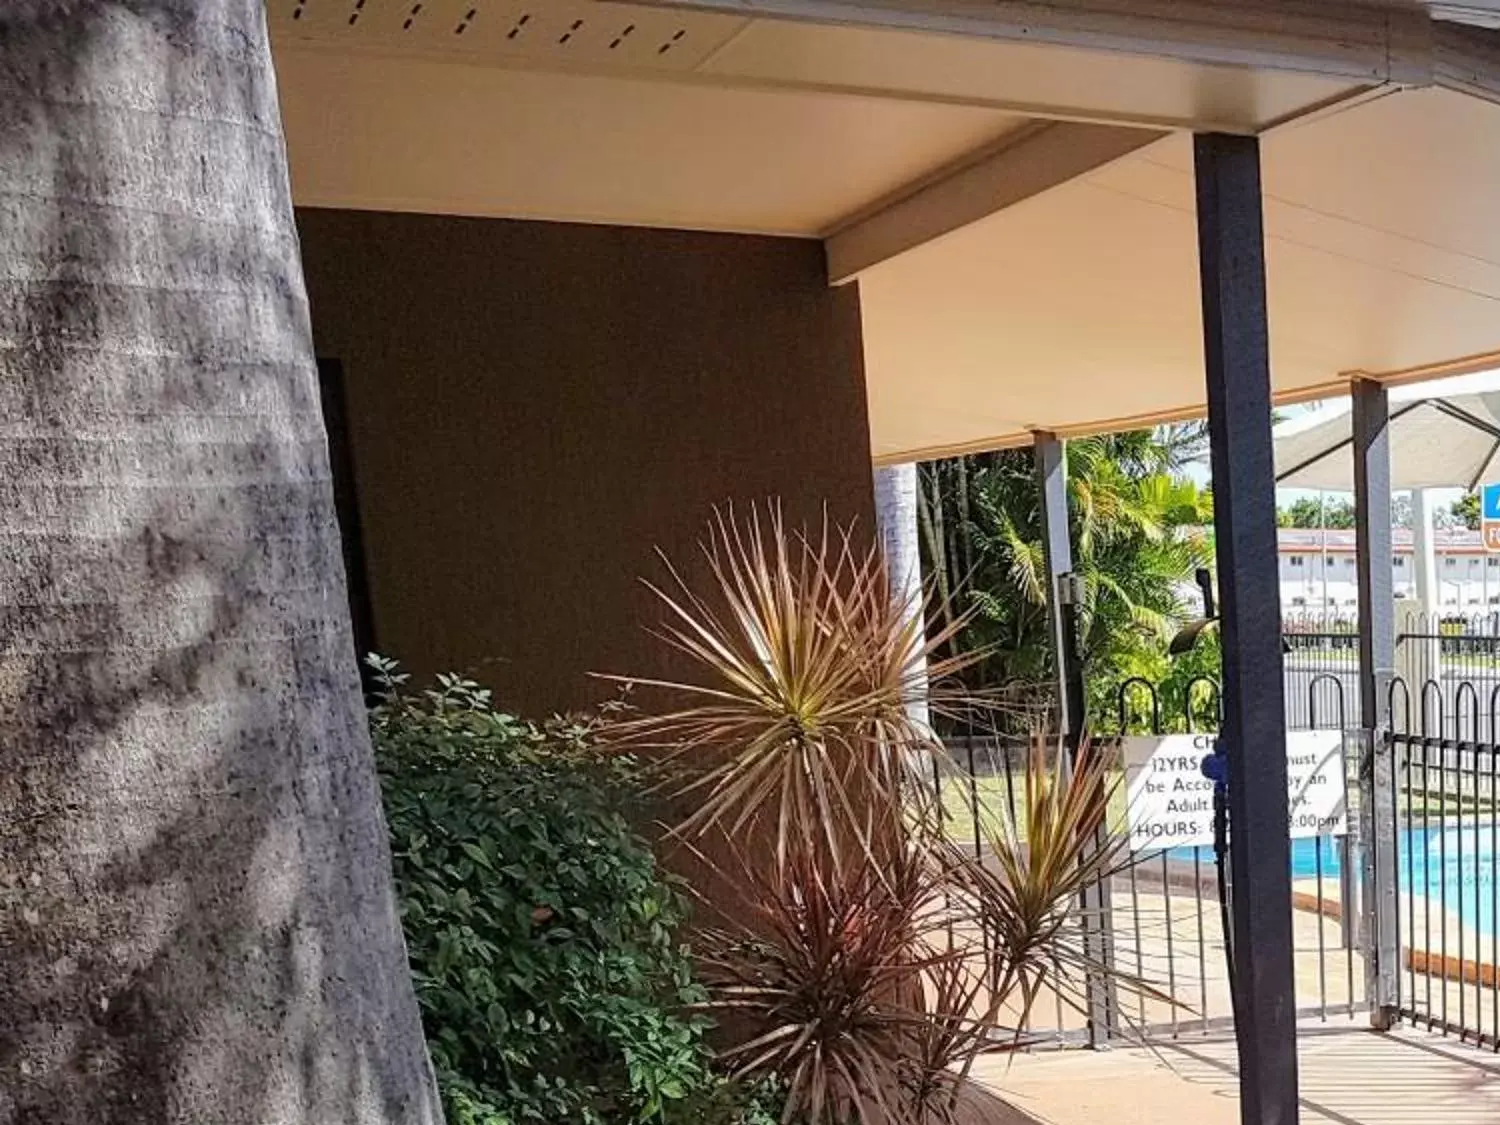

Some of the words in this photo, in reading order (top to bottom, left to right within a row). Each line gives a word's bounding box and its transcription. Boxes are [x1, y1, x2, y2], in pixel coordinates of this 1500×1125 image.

[1152, 755, 1198, 773] 12YRS
[1145, 779, 1165, 793] be
[1173, 777, 1212, 792] Acco
[1309, 774, 1328, 785] an
[1136, 821, 1202, 838] HOURS:
